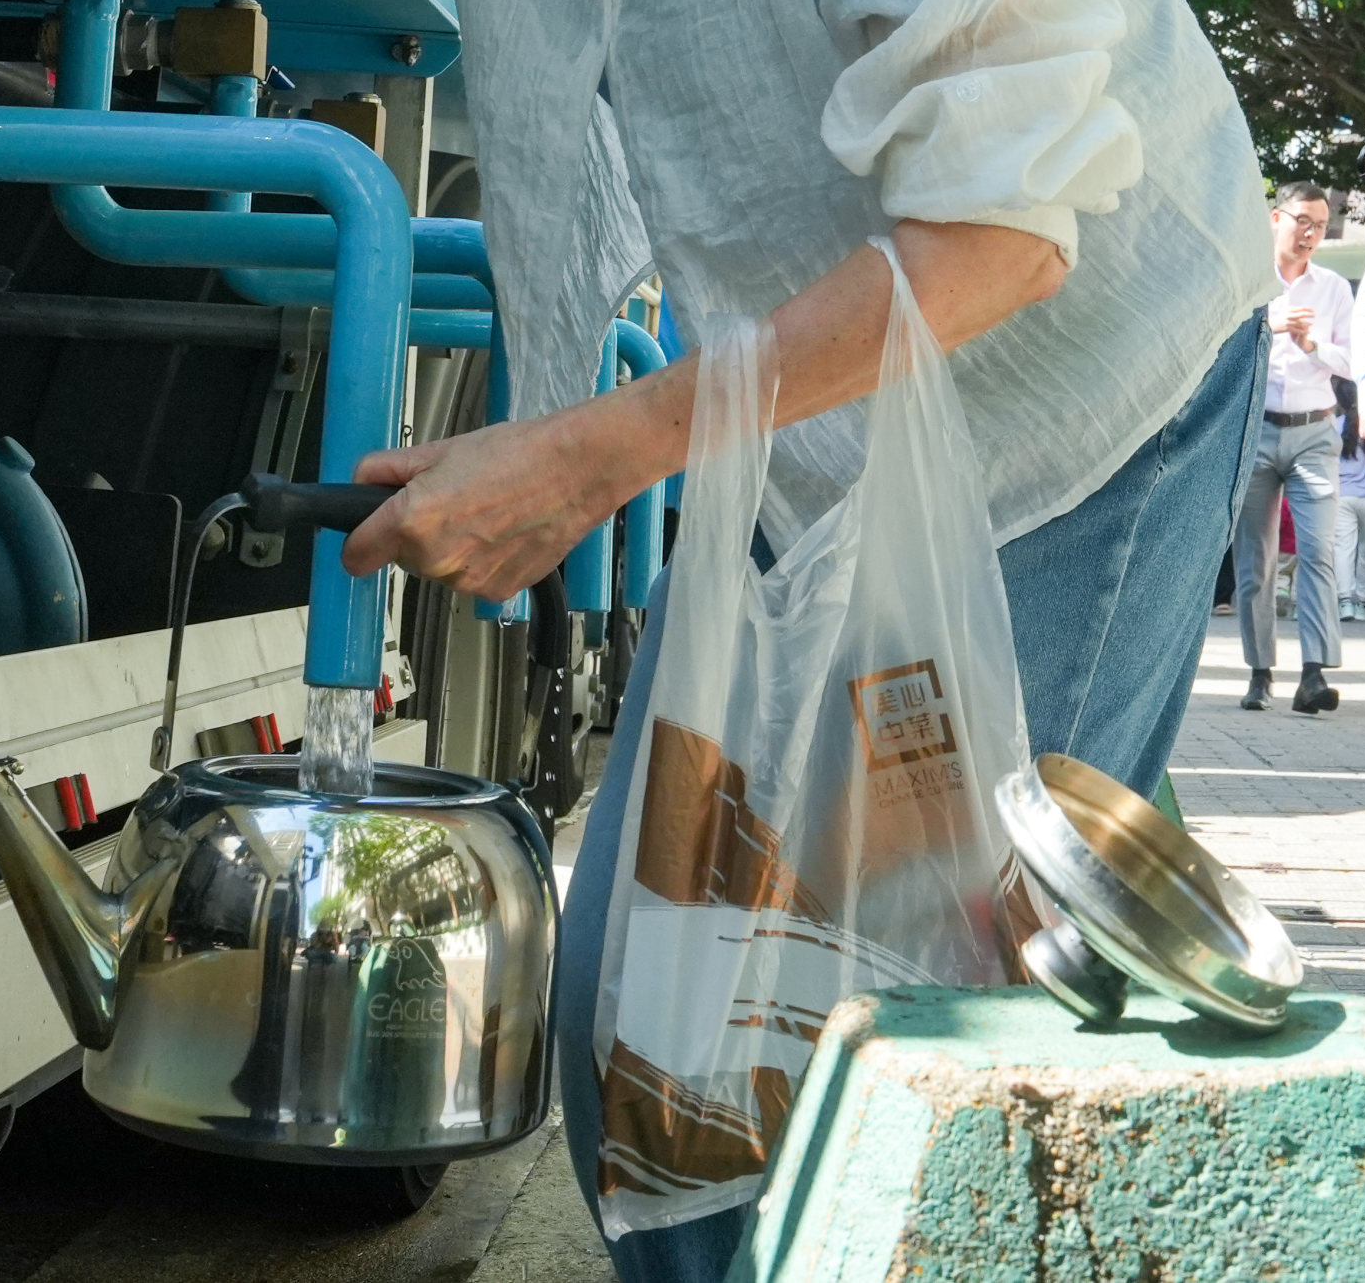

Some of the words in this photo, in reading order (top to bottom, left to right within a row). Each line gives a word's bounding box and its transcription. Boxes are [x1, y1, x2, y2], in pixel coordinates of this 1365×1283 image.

[875, 683, 926, 716] 美心
[878, 712, 934, 742] 中菜
[874, 761, 962, 797] MAXIM'S
[367, 993, 445, 1021] EAGLE
